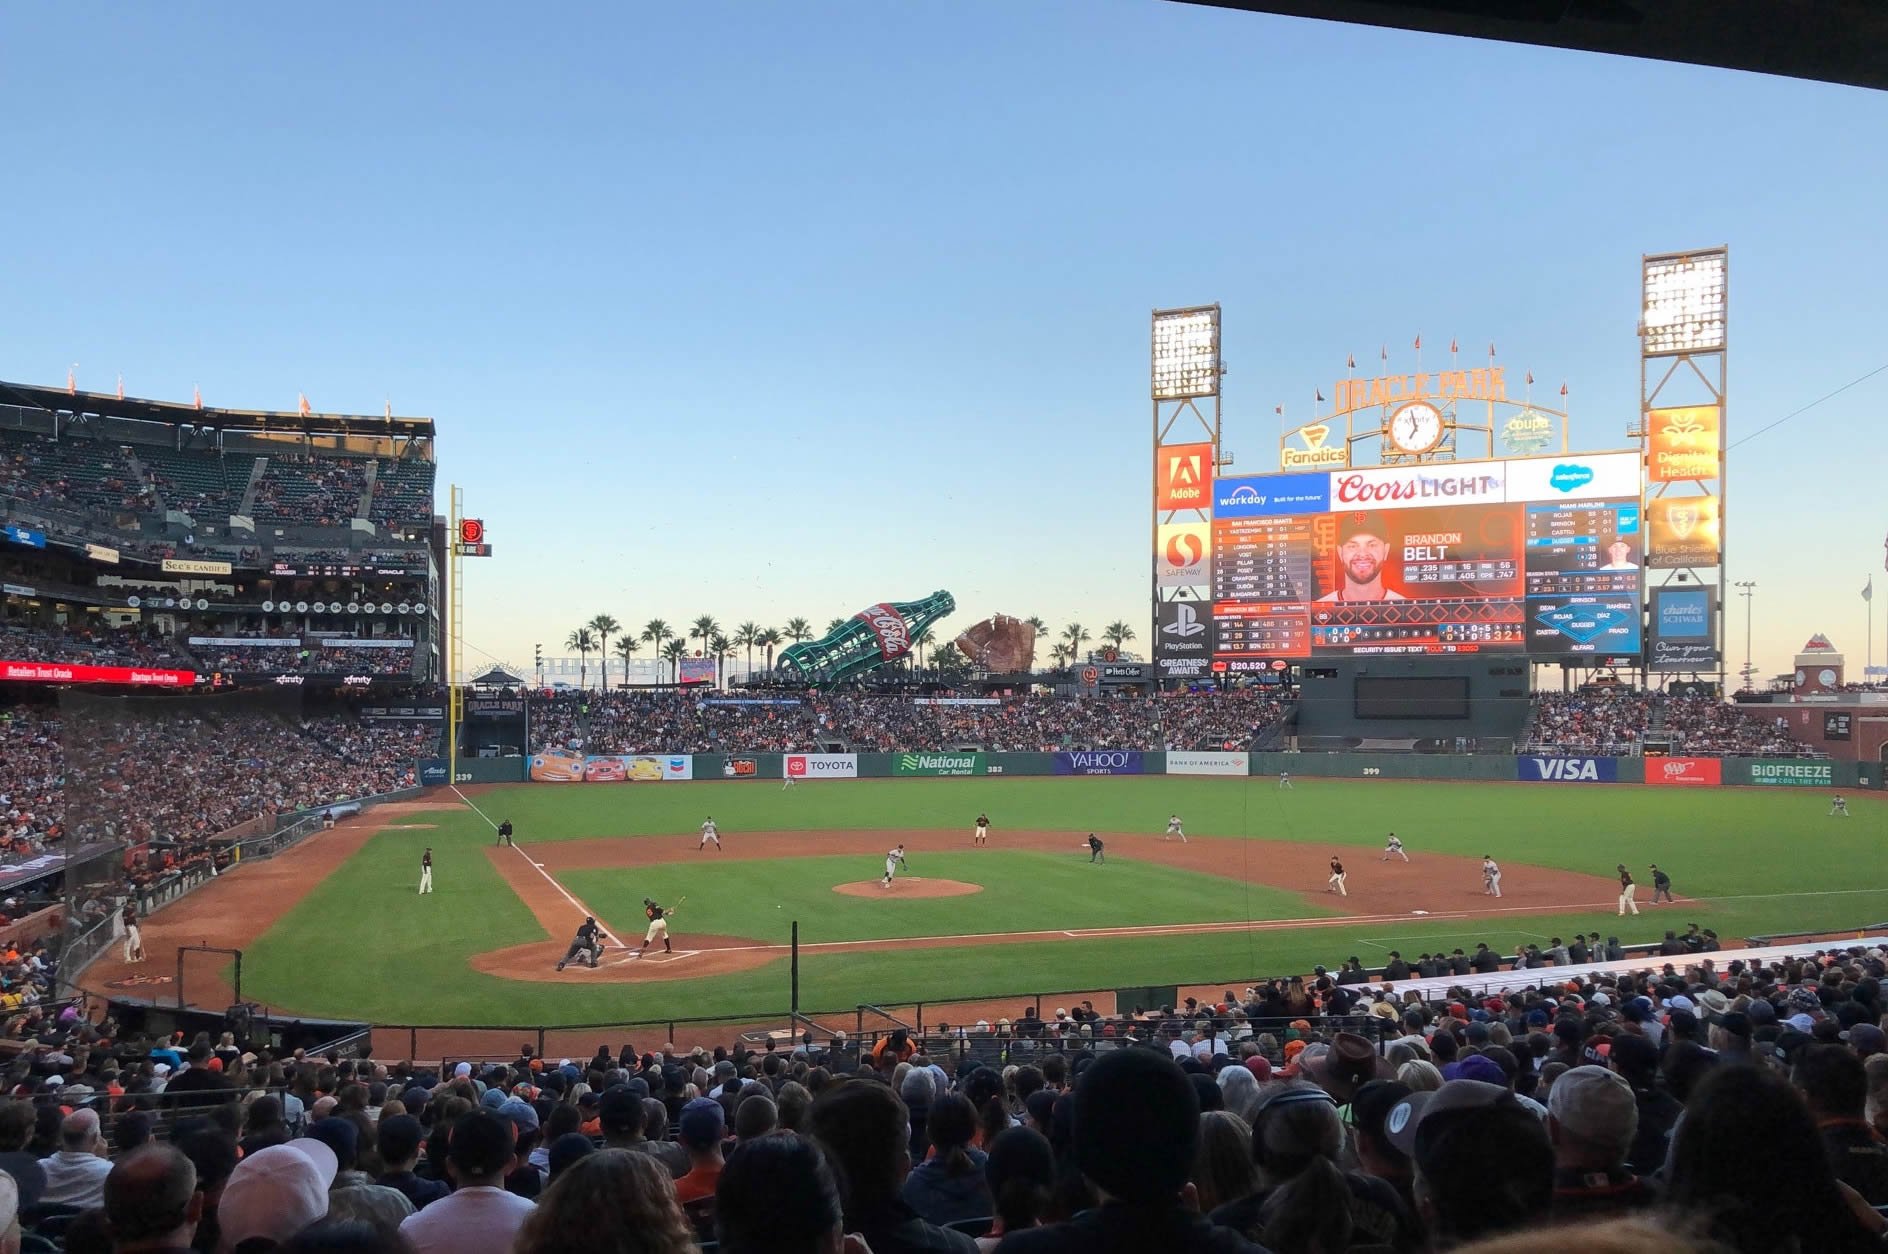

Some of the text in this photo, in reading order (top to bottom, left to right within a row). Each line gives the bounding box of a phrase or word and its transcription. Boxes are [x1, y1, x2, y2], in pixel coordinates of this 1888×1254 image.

[1336, 368, 1505, 413] ORACLE PARK
[1285, 448, 1345, 464] Fanatics
[1661, 465, 1705, 477] Health
[1170, 488, 1200, 499] Adobe
[1337, 475, 1491, 503] Coors LIGHT
[1220, 495, 1266, 506] workday
[1405, 533, 1461, 545] BRANDON
[1404, 546, 1448, 561] BELT
[1656, 545, 1676, 554] Blue
[165, 560, 228, 573] See's CANDIES
[1167, 568, 1201, 576] SAFEWAY
[1421, 573, 1438, 581] .342
[1664, 604, 1702, 614] charles
[1494, 631, 1501, 640] 3
[1504, 631, 1512, 640] 2
[1516, 631, 1521, 640] 1
[1165, 642, 1203, 651] PlayStation
[1656, 642, 1711, 656] Own your
[1160, 658, 1208, 667] GREATNESS
[1655, 654, 1713, 663] tomorrow
[1231, 661, 1266, 670] $20,520
[8, 666, 72, 679] Retailers Trust Oracle
[275, 675, 304, 685] xfinity
[344, 675, 372, 685] xfinity
[810, 761, 854, 770] TOYOTA
[919, 755, 976, 768] National
[1070, 752, 1128, 768] YAHOO!
[1532, 759, 1599, 780] VISA
